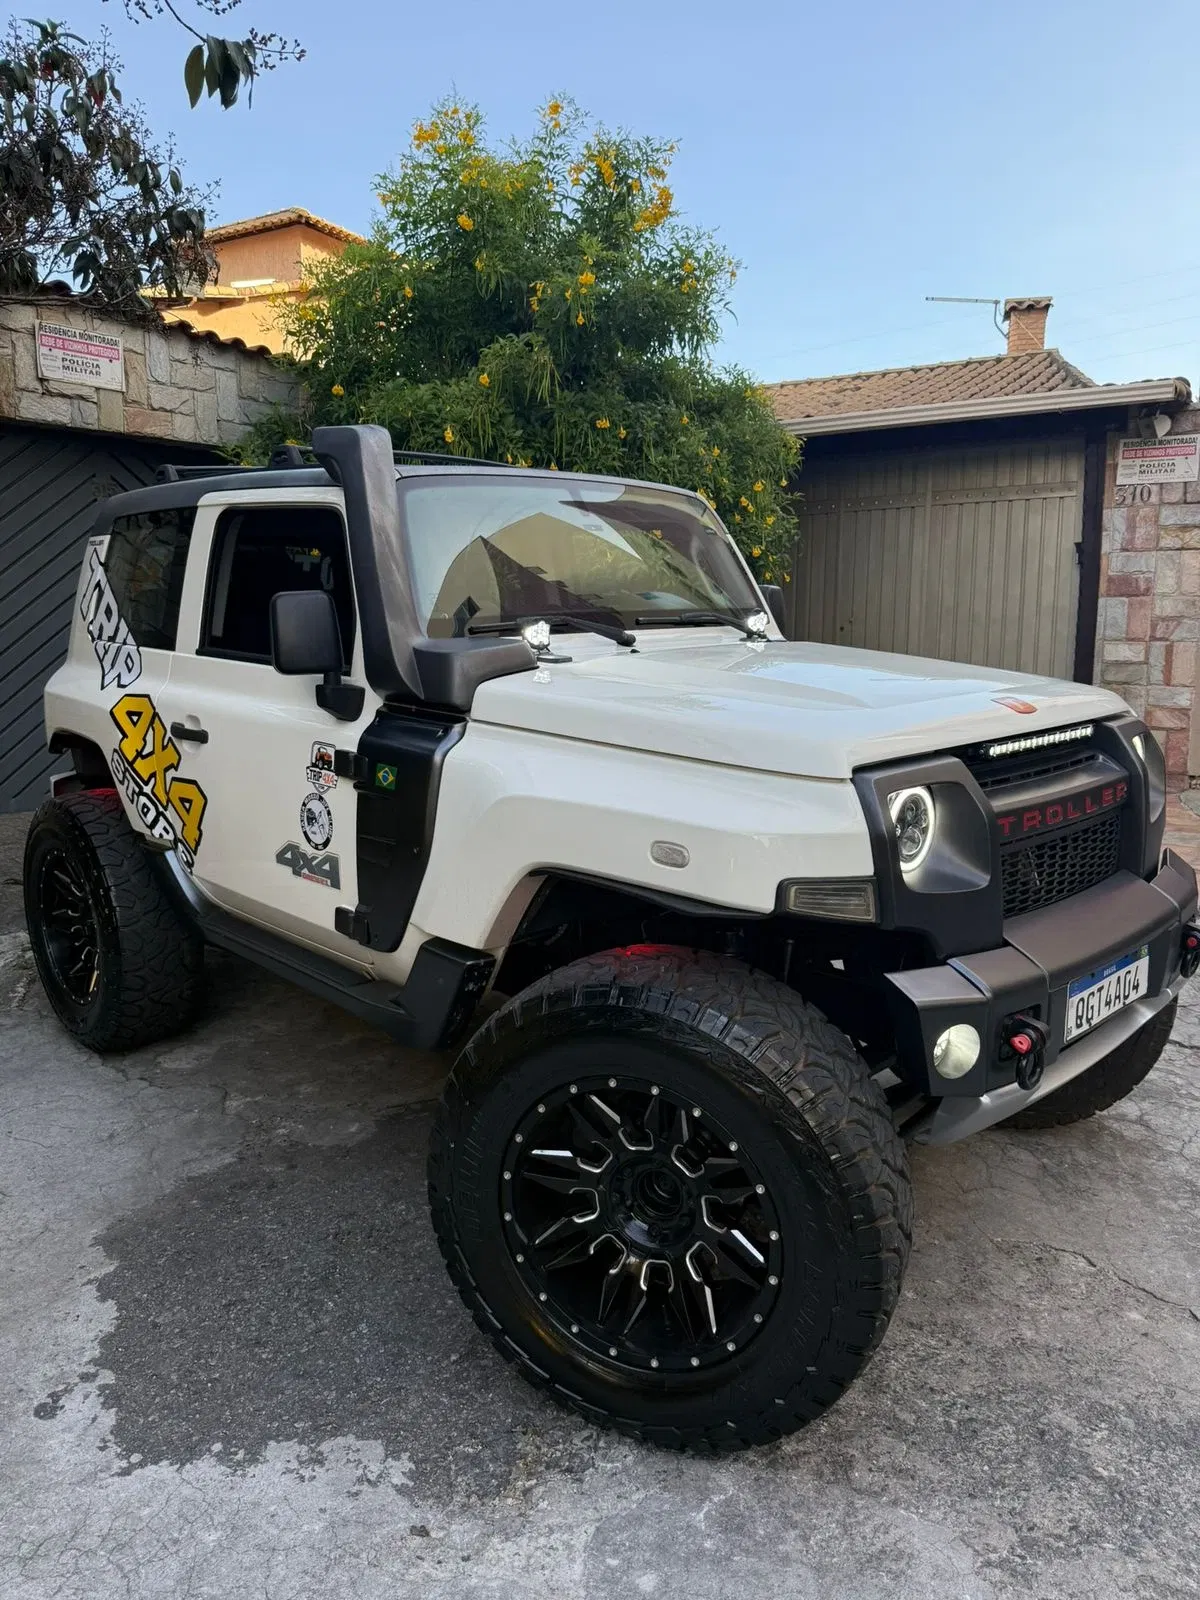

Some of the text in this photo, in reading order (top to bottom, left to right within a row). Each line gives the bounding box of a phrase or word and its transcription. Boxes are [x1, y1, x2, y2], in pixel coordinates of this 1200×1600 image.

[41, 335, 119, 359] REDE DE VIZINHOS PROTEGIDOS
[62, 357, 101, 370] POLÍCIA
[62, 365, 101, 377] MILITAR
[1166, 446, 1196, 456] PROTEGIDOS
[1139, 461, 1176, 469] POLÍCIA
[1115, 485, 1152, 506] 310
[80, 547, 143, 690] TRIP
[110, 693, 208, 856] 4X4
[308, 769, 322, 783] TRIP
[996, 782, 1129, 836] TROLLER
[1075, 965, 1140, 1030] QGT4A04
